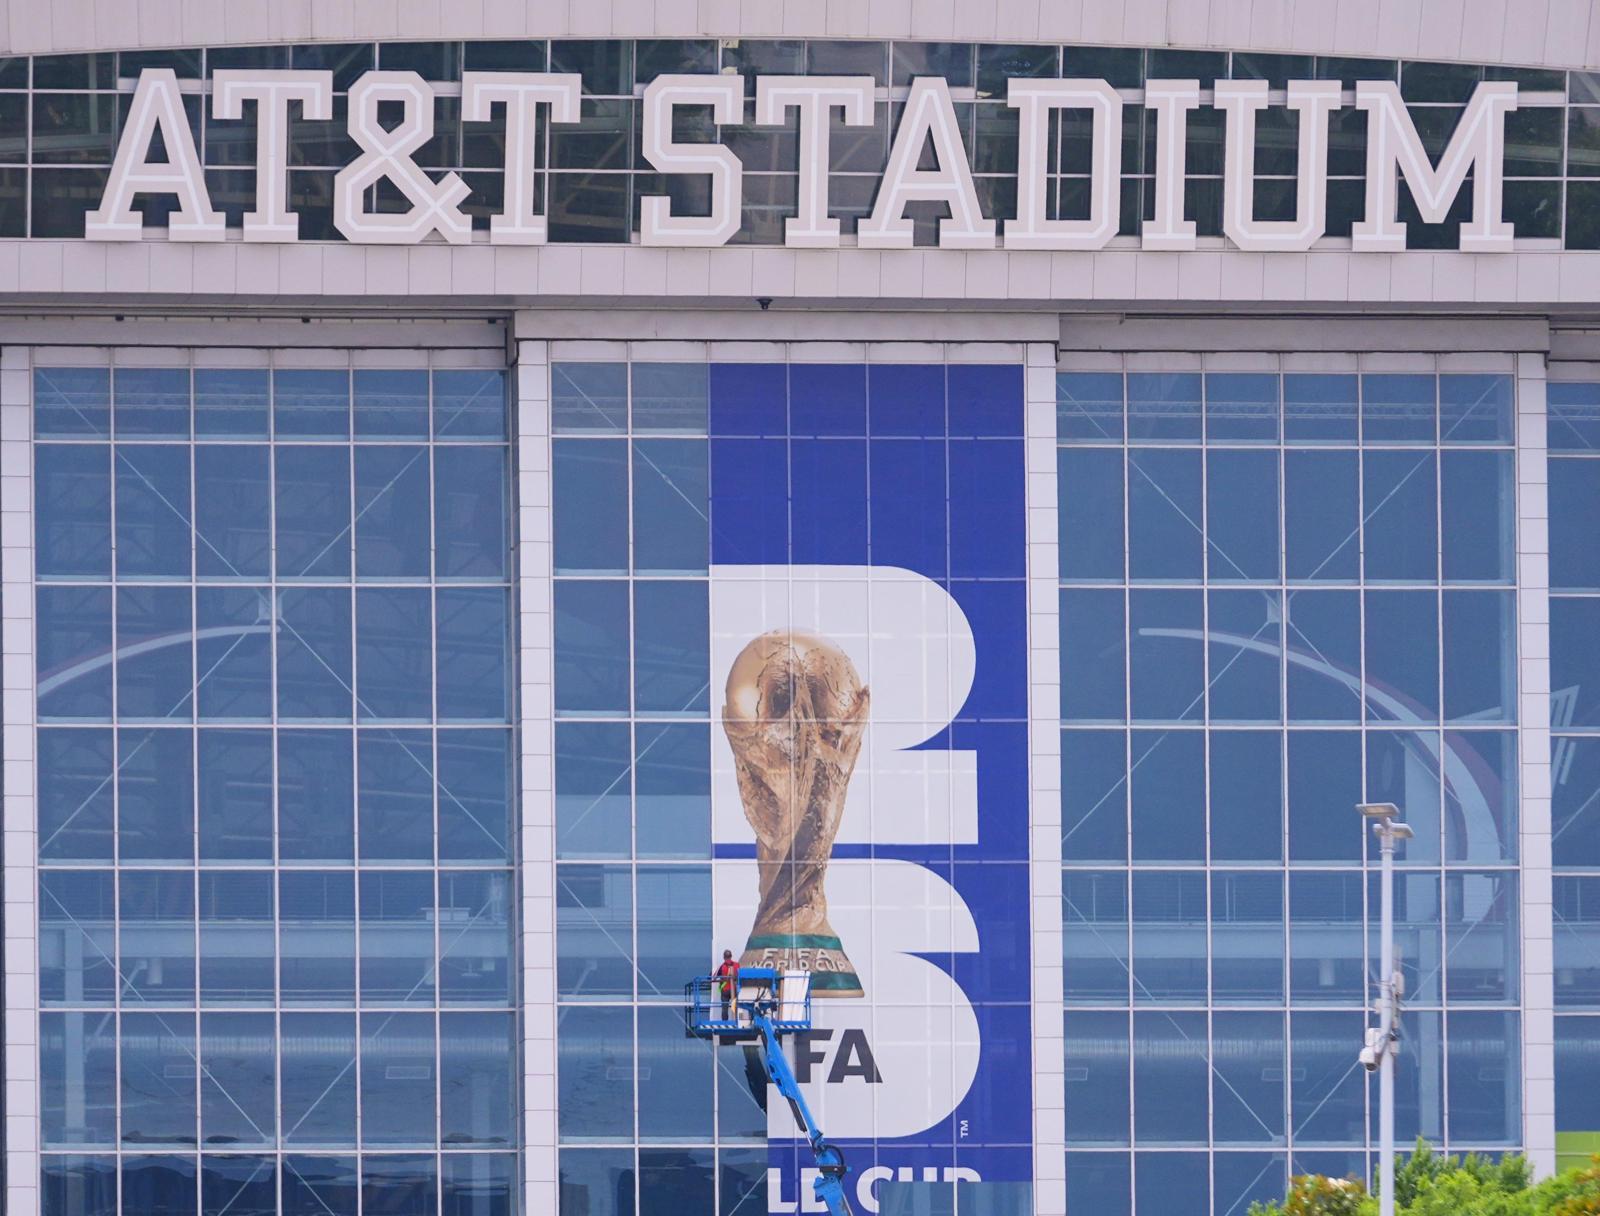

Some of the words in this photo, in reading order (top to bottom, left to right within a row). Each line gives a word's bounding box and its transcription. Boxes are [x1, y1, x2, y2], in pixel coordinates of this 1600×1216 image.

[85, 67, 582, 245] AT&T
[640, 73, 1518, 253] STADIUM
[762, 947, 831, 961] FIFA
[750, 960, 810, 972] WORLD
[815, 960, 846, 972] CUP
[960, 1119, 969, 1138] TM
